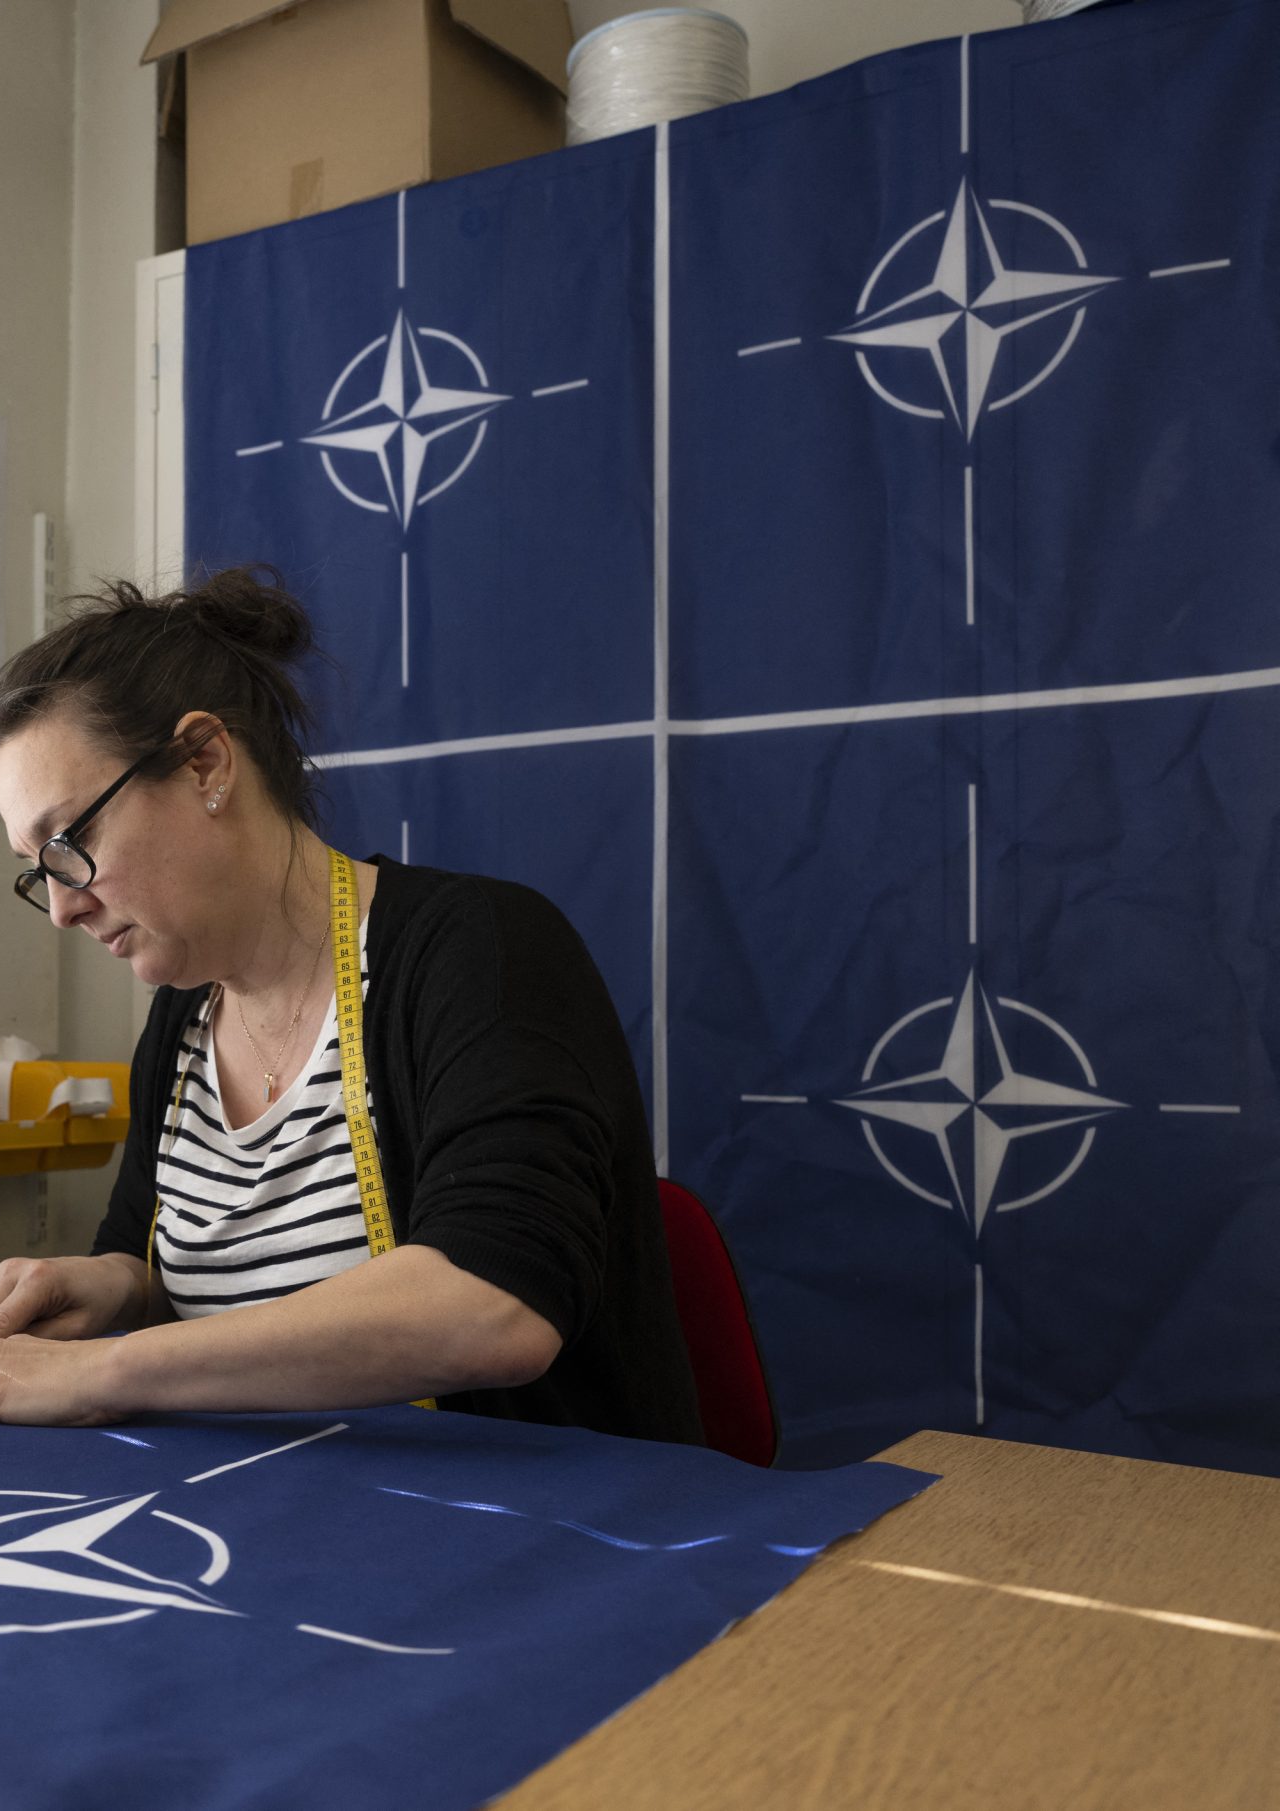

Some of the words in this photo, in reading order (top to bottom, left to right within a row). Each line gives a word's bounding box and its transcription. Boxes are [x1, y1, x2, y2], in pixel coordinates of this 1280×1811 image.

[340, 935, 348, 943] 63
[341, 948, 348, 956] 64
[342, 962, 349, 970] 65
[343, 976, 350, 984] 66
[343, 990, 351, 999] 67
[344, 1004, 352, 1012] 68
[345, 1018, 352, 1026] 69
[346, 1032, 354, 1041] 70
[348, 1048, 354, 1056] 71
[349, 1076, 356, 1084] 73
[350, 1090, 356, 1098] 74
[352, 1105, 358, 1114] 75
[354, 1120, 362, 1129] 76
[357, 1136, 364, 1144] 77
[360, 1151, 368, 1160] 78
[363, 1166, 372, 1176] 79
[366, 1182, 373, 1190] 80
[369, 1197, 376, 1206] 81
[372, 1213, 380, 1223] 82
[375, 1228, 383, 1237] 83
[378, 1244, 385, 1253] 84
